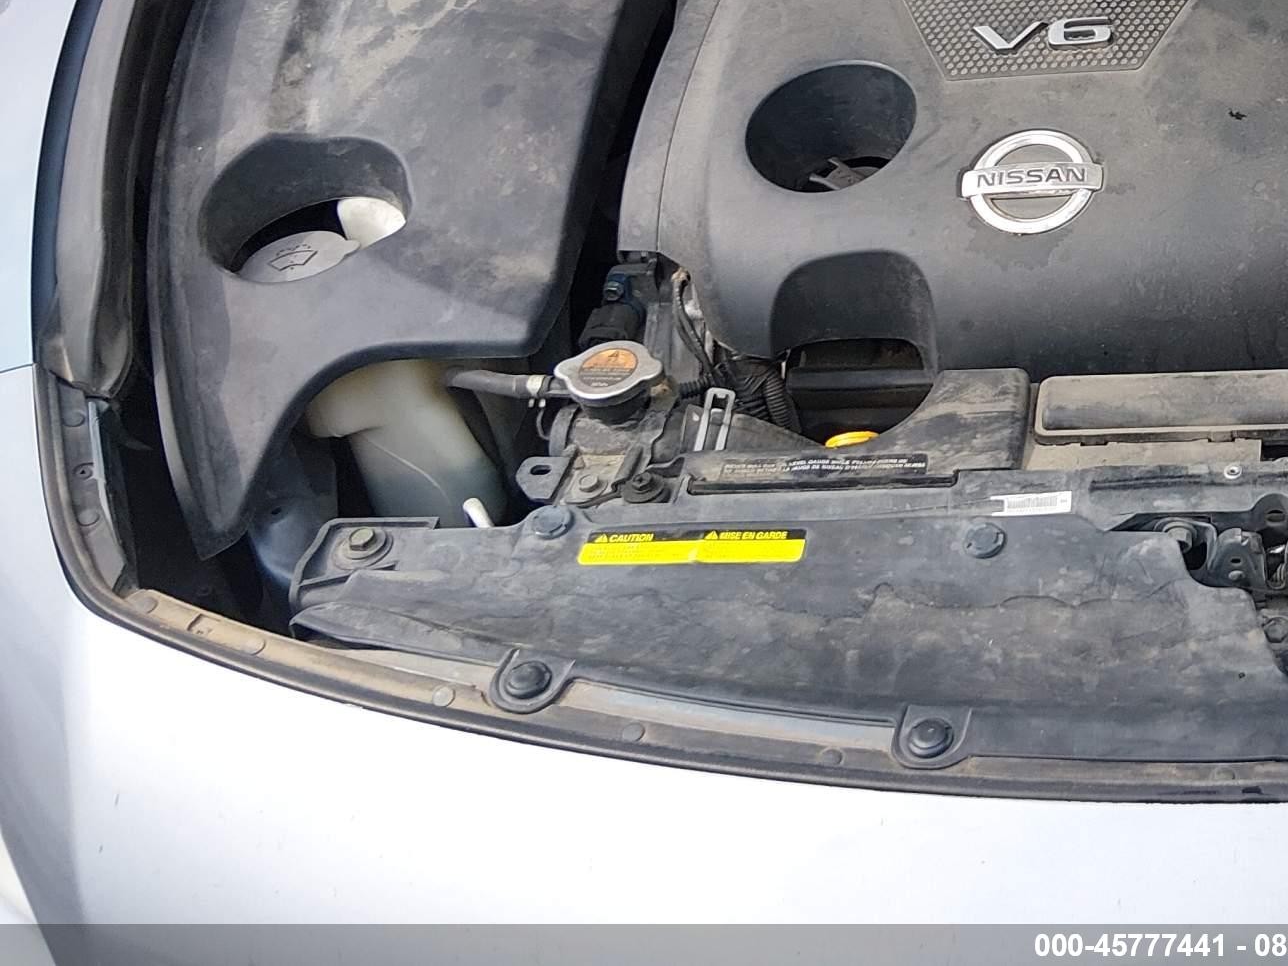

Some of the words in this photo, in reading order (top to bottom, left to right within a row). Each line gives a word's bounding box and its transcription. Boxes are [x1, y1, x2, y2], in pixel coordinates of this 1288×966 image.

[973, 15, 1113, 50] V6
[977, 167, 1086, 189] NISSAN
[608, 533, 655, 543] CAUTION
[719, 531, 742, 540] MISE
[742, 531, 755, 540] EN
[755, 531, 788, 540] GARDE
